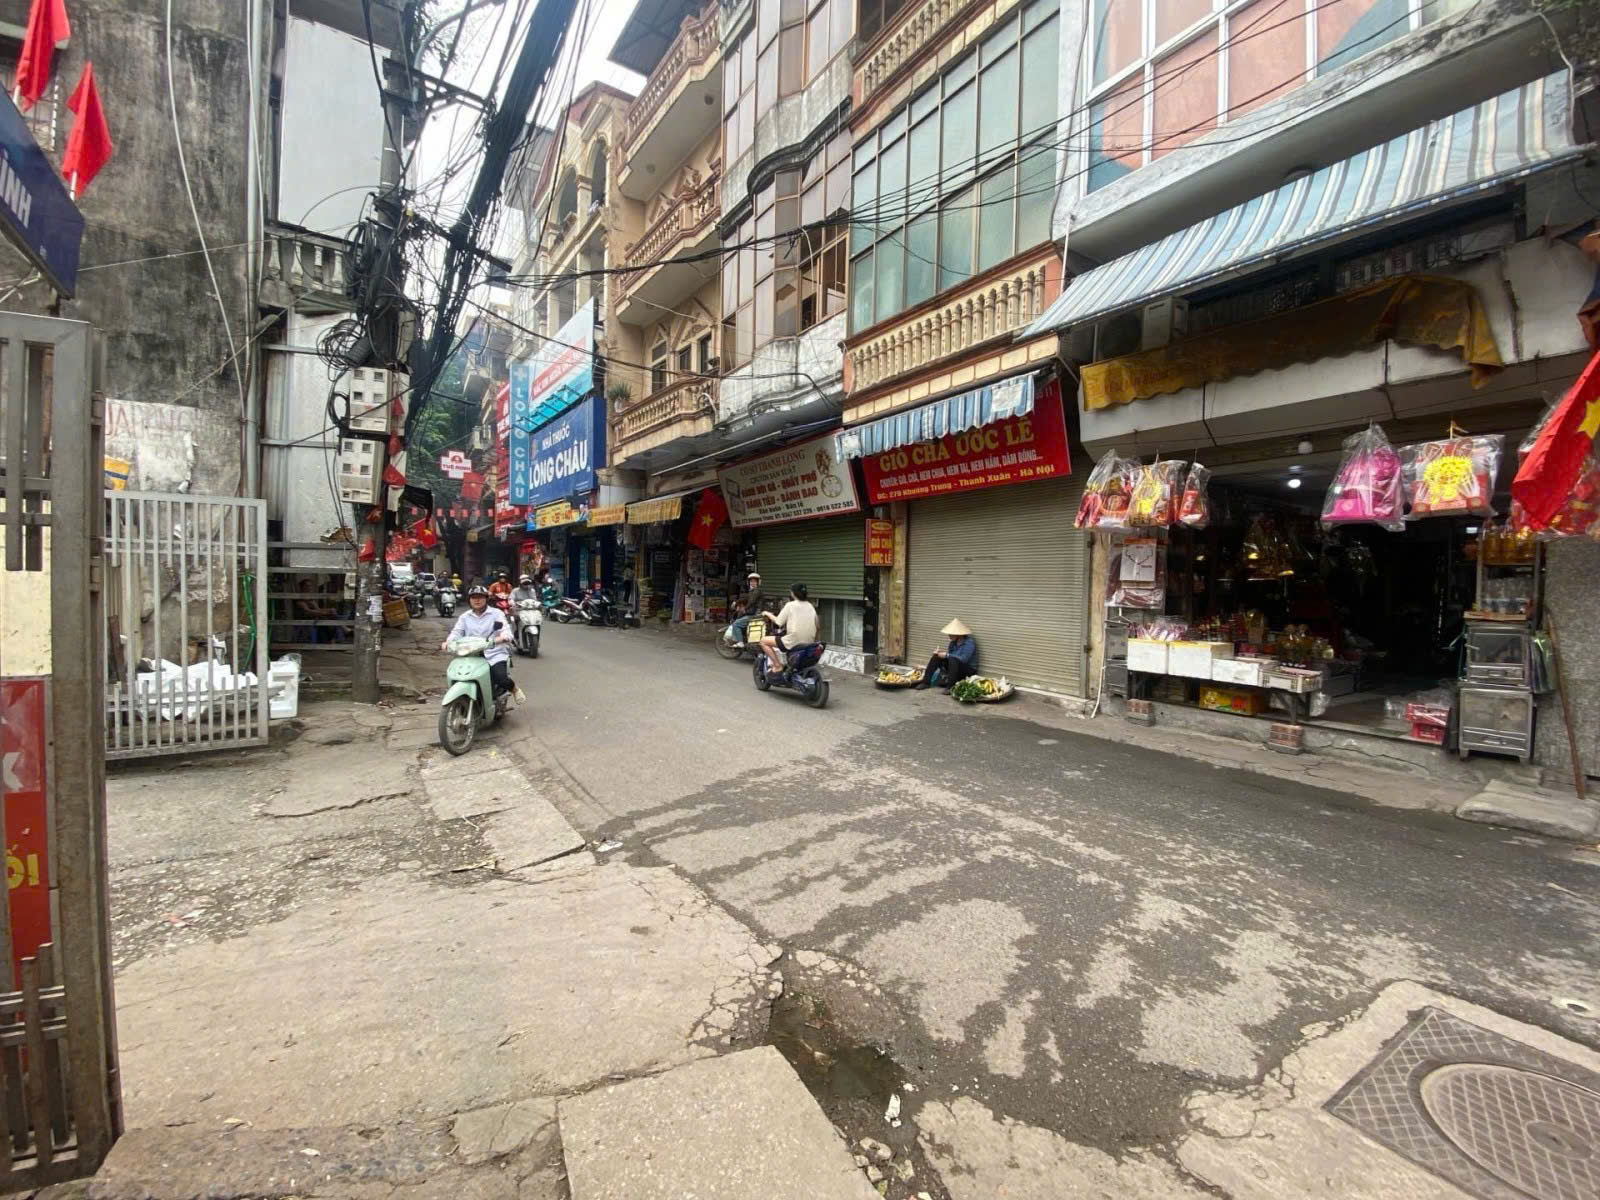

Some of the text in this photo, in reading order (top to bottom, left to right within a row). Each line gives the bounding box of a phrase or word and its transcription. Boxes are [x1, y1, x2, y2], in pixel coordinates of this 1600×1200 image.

[529, 440, 588, 490] LONG CHÂU
[959, 477, 985, 487] Thanh
